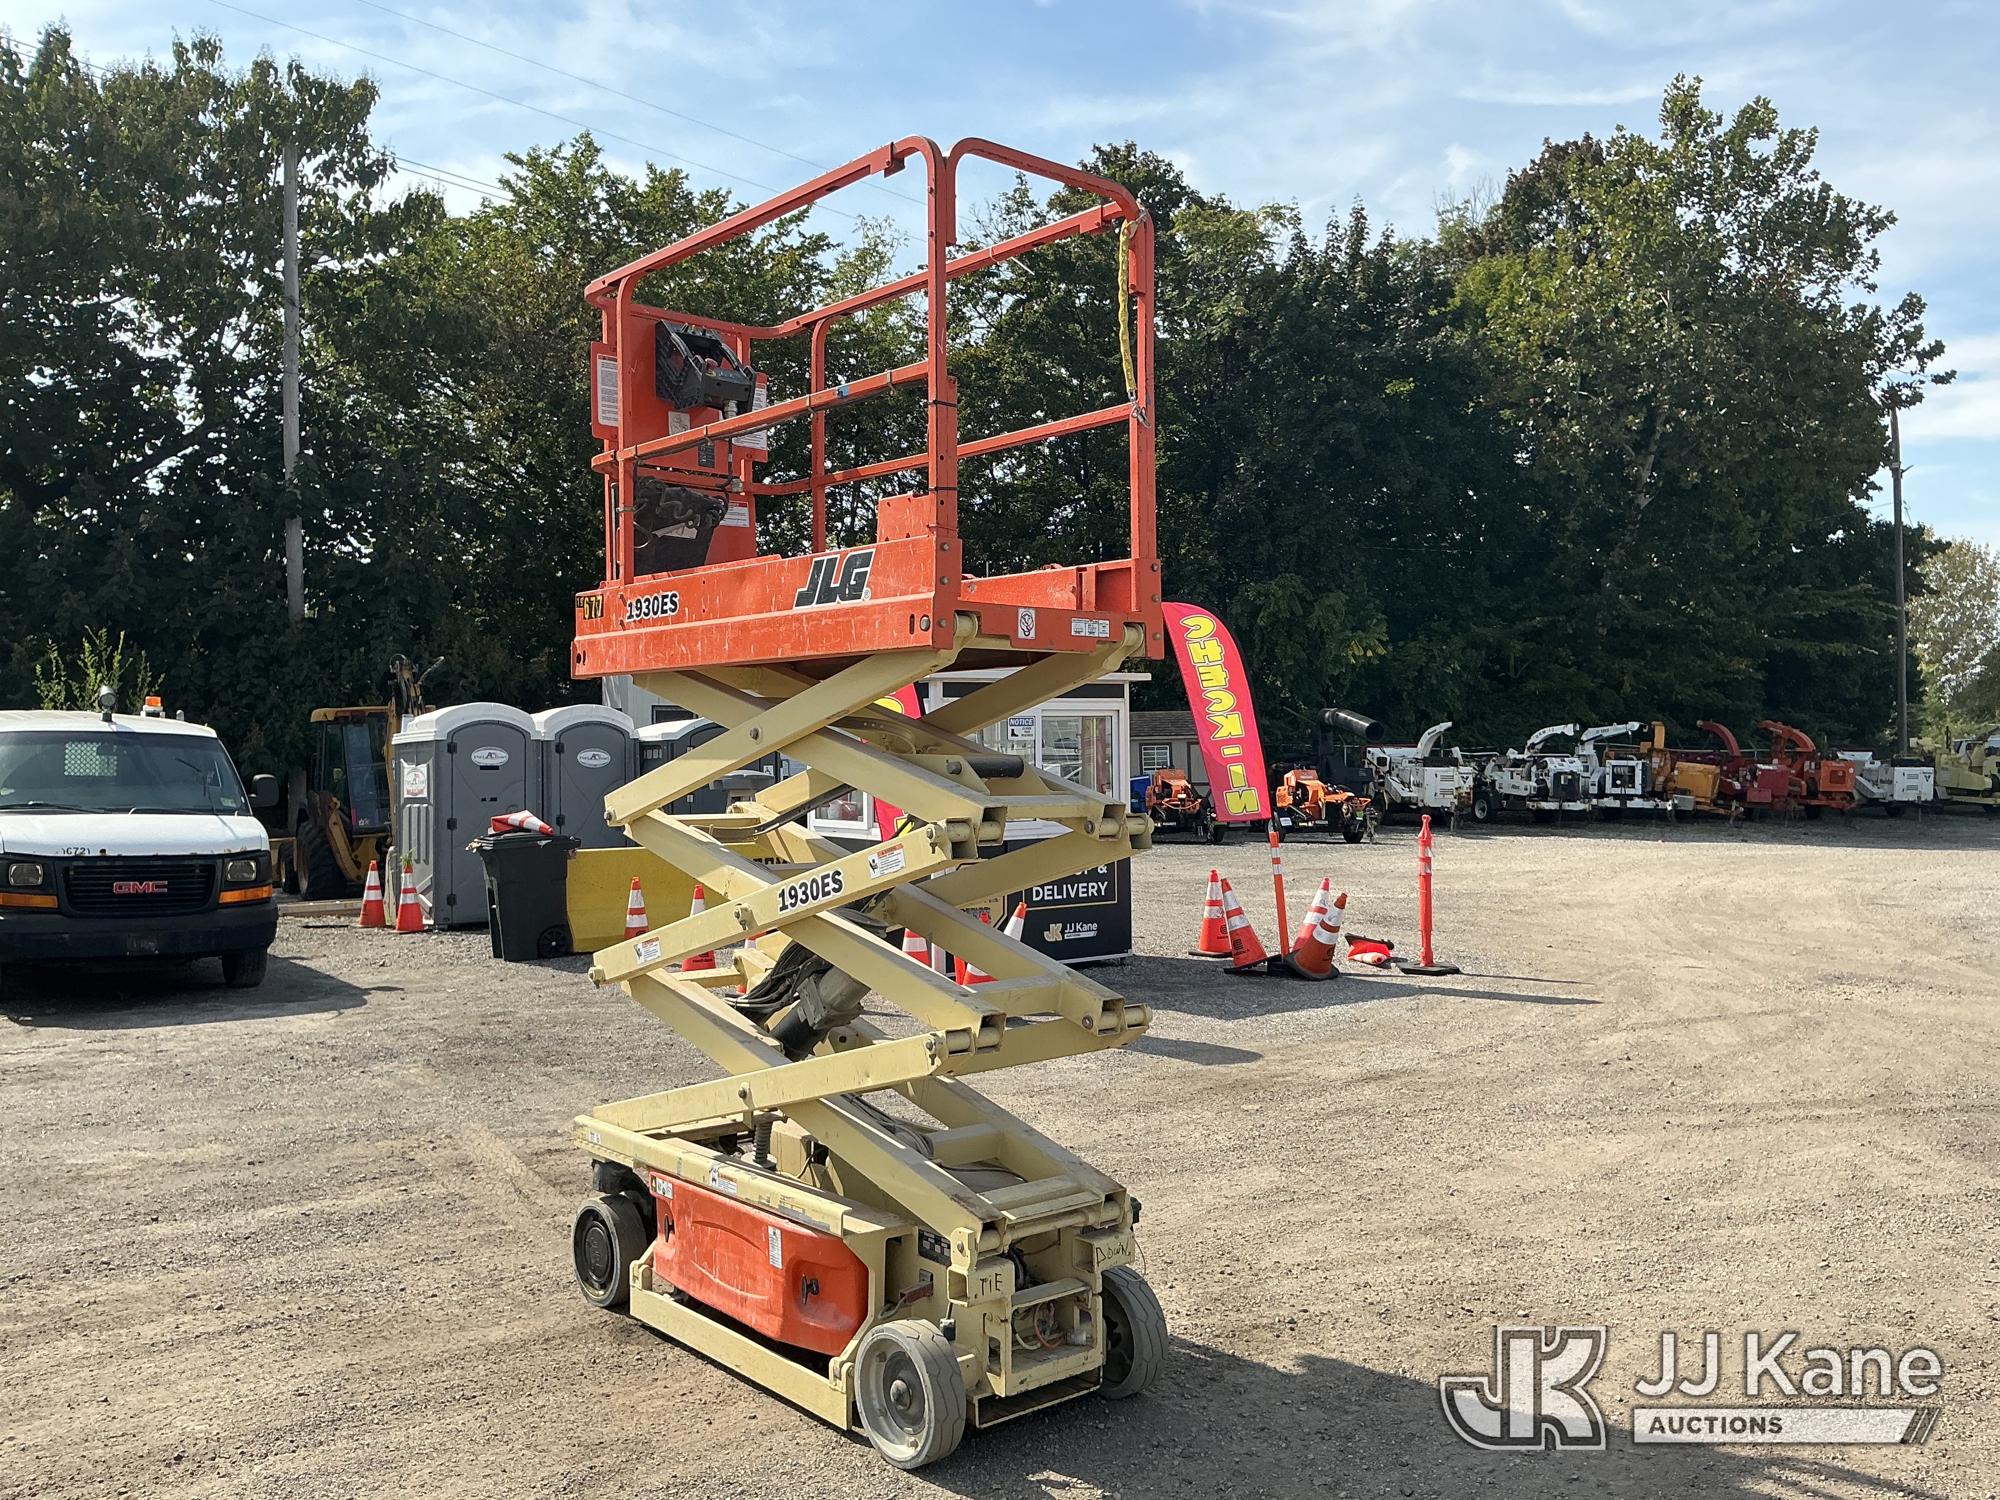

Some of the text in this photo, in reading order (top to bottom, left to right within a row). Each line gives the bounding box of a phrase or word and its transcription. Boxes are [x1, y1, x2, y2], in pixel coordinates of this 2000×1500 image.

[795, 550, 875, 607] JLG
[627, 592, 679, 620] 1930ES
[113, 881, 168, 894] GMC
[778, 870, 843, 912] 1930ES
[1032, 881, 1108, 901] DELIVERY
[1065, 923, 1075, 933] JJ
[1076, 921, 1098, 932] Kane
